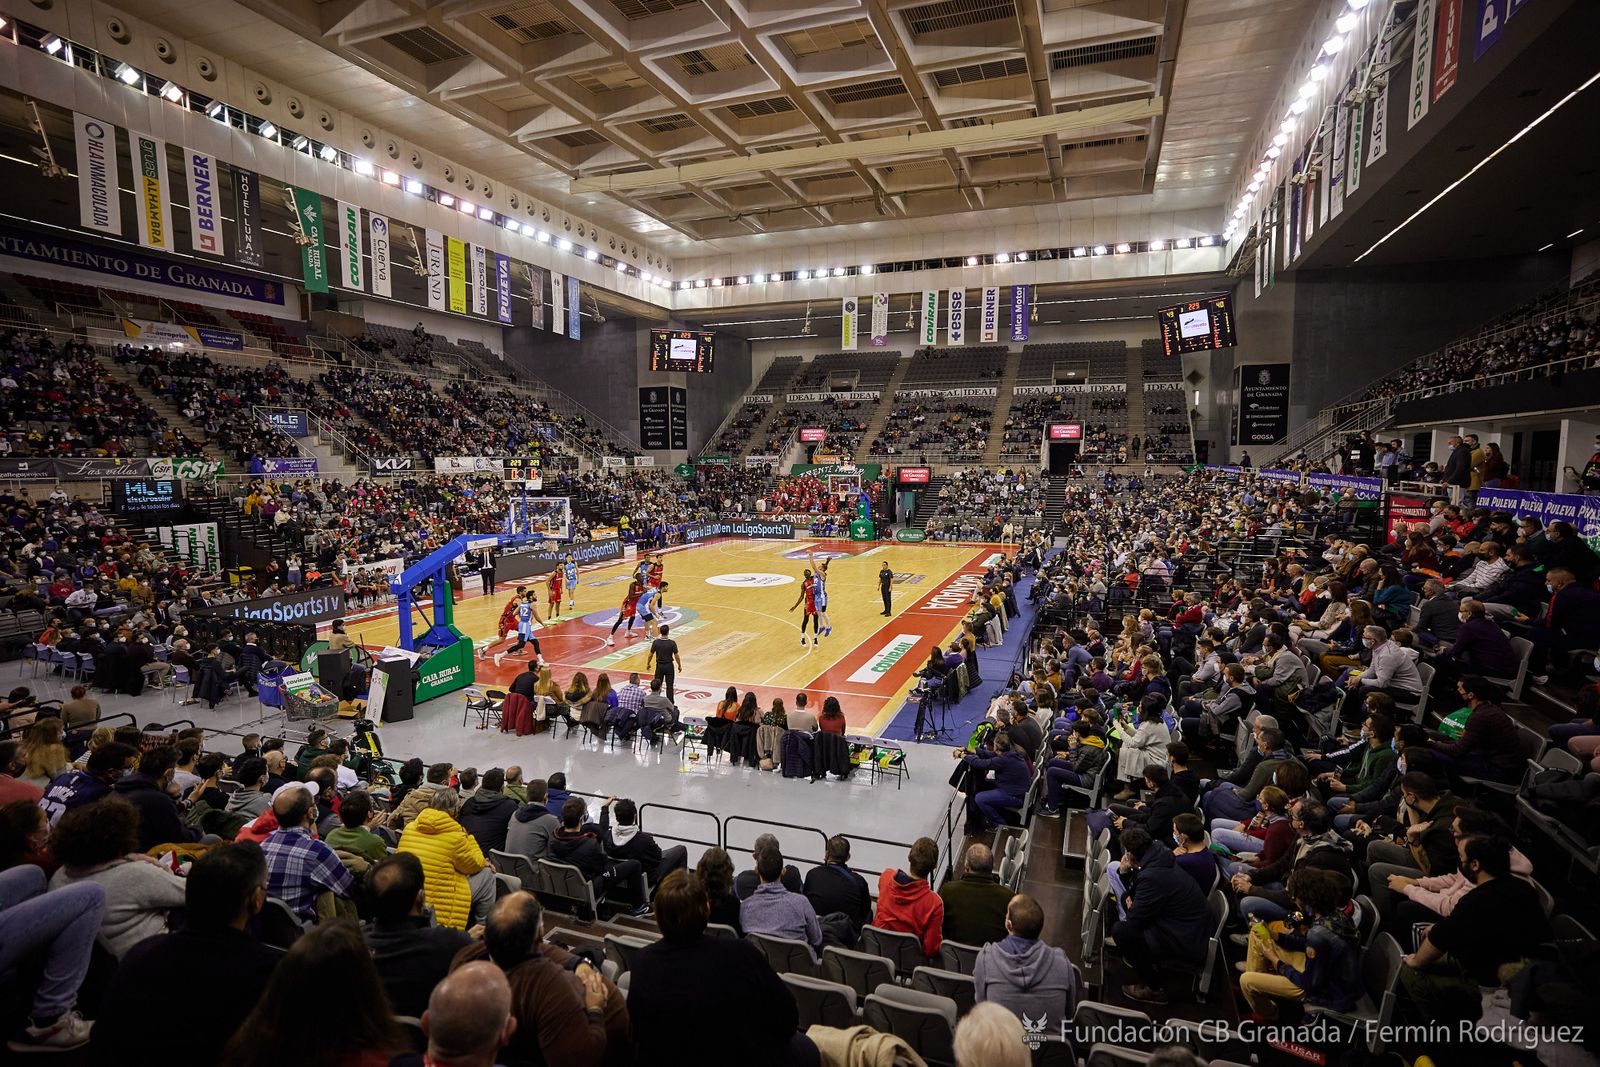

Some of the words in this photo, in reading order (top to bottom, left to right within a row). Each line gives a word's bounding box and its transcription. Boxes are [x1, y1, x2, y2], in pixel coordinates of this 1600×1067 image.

[141, 139, 157, 180] gruas
[192, 154, 214, 232] BERNER
[241, 175, 250, 216] HOTEL
[145, 178, 162, 244] ALHAMBRA
[244, 218, 253, 251] LUNA
[346, 206, 361, 287] COVIRAN
[376, 238, 388, 281] Cuerva
[134, 263, 162, 279] DE
[478, 260, 488, 314] ESCOLANO
[499, 259, 510, 319] PULEVA
[926, 293, 937, 343] COVIRAN
[984, 288, 996, 330] BERNER
[1015, 313, 1023, 336] Mica
[788, 393, 816, 402] IDEAL
[849, 392, 879, 400] IDEAL
[963, 387, 996, 396] IDEAL
[1015, 386, 1047, 395] IDEAL
[1052, 384, 1085, 393] IDEAL
[1090, 384, 1124, 392] IDEAL
[1146, 383, 1182, 391] IDEAL
[67, 460, 102, 476] Las
[154, 466, 172, 474] CSIF
[510, 459, 522, 467] 229
[529, 459, 541, 467] 229
[1491, 496, 1518, 509] PULEVA
[1519, 498, 1544, 513] PULEVA
[1545, 502, 1577, 518] PULEVA
[721, 524, 731, 533] en
[732, 523, 792, 537] LaLigaSportsTV
[870, 641, 914, 673] COVIRAN
[286, 675, 313, 686] COVIRAN
[421, 673, 438, 685] CAJA
[437, 667, 461, 679] RURAL
[429, 675, 454, 688] GRANADA
